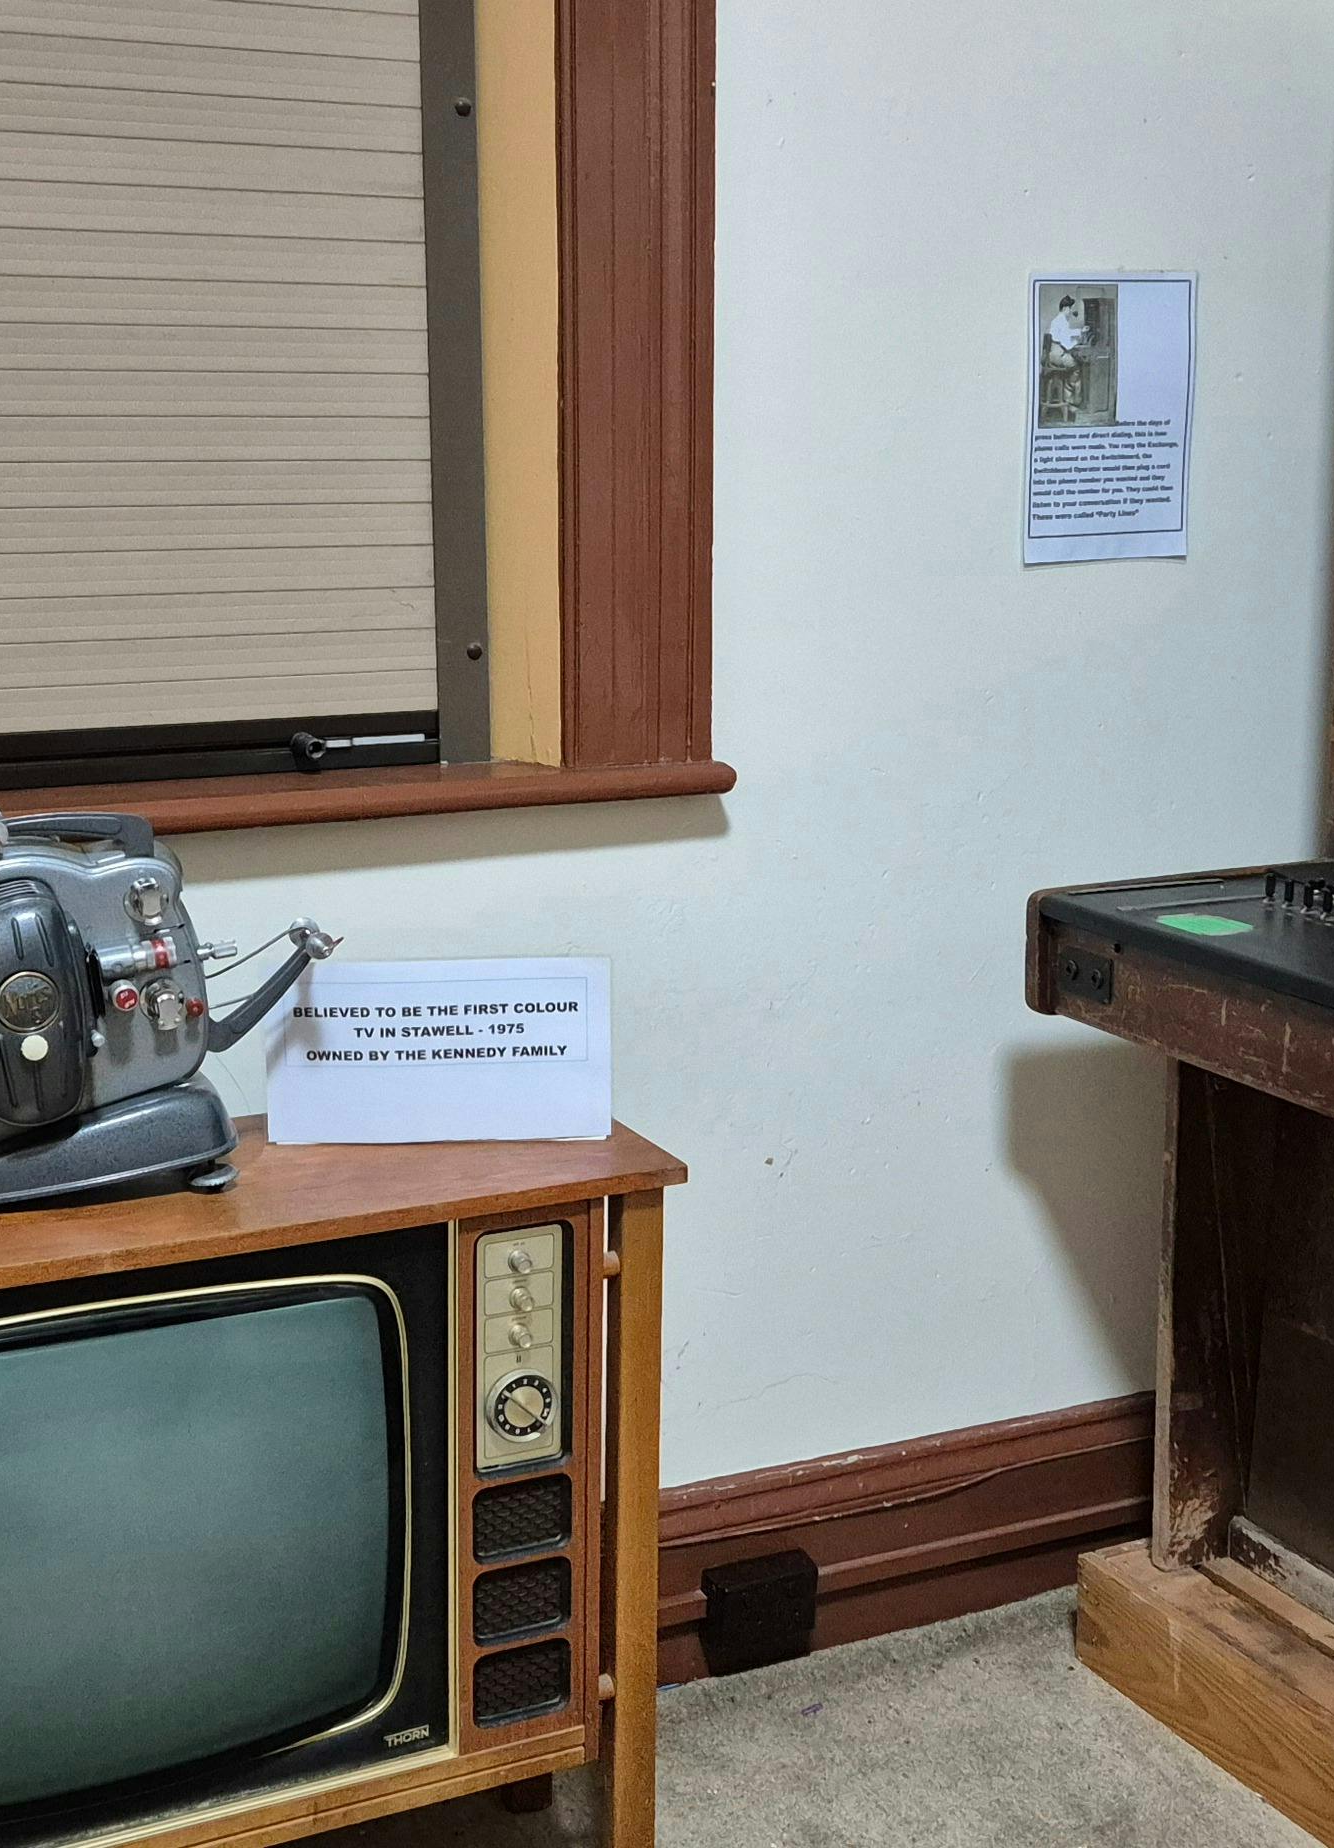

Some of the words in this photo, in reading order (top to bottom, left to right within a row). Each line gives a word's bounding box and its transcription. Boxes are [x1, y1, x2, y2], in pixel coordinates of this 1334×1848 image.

[293, 1006, 370, 1019] BELIEVED
[375, 1006, 396, 1018] TO
[402, 1005, 422, 1018] BE
[427, 1004, 459, 1017] THE
[463, 1003, 509, 1015] FIRST
[513, 1001, 578, 1014] COLOUR
[354, 1027, 375, 1039] TV
[379, 1026, 396, 1038] IN
[401, 1024, 474, 1038] STAWELL
[488, 1023, 525, 1035] 1975
[306, 1049, 363, 1062] OWNED
[368, 1049, 391, 1061] BY
[395, 1048, 426, 1061] THE
[431, 1046, 508, 1060] KENNEDY
[512, 1044, 567, 1057] FAMILY
[383, 1724, 430, 1748] THORN
